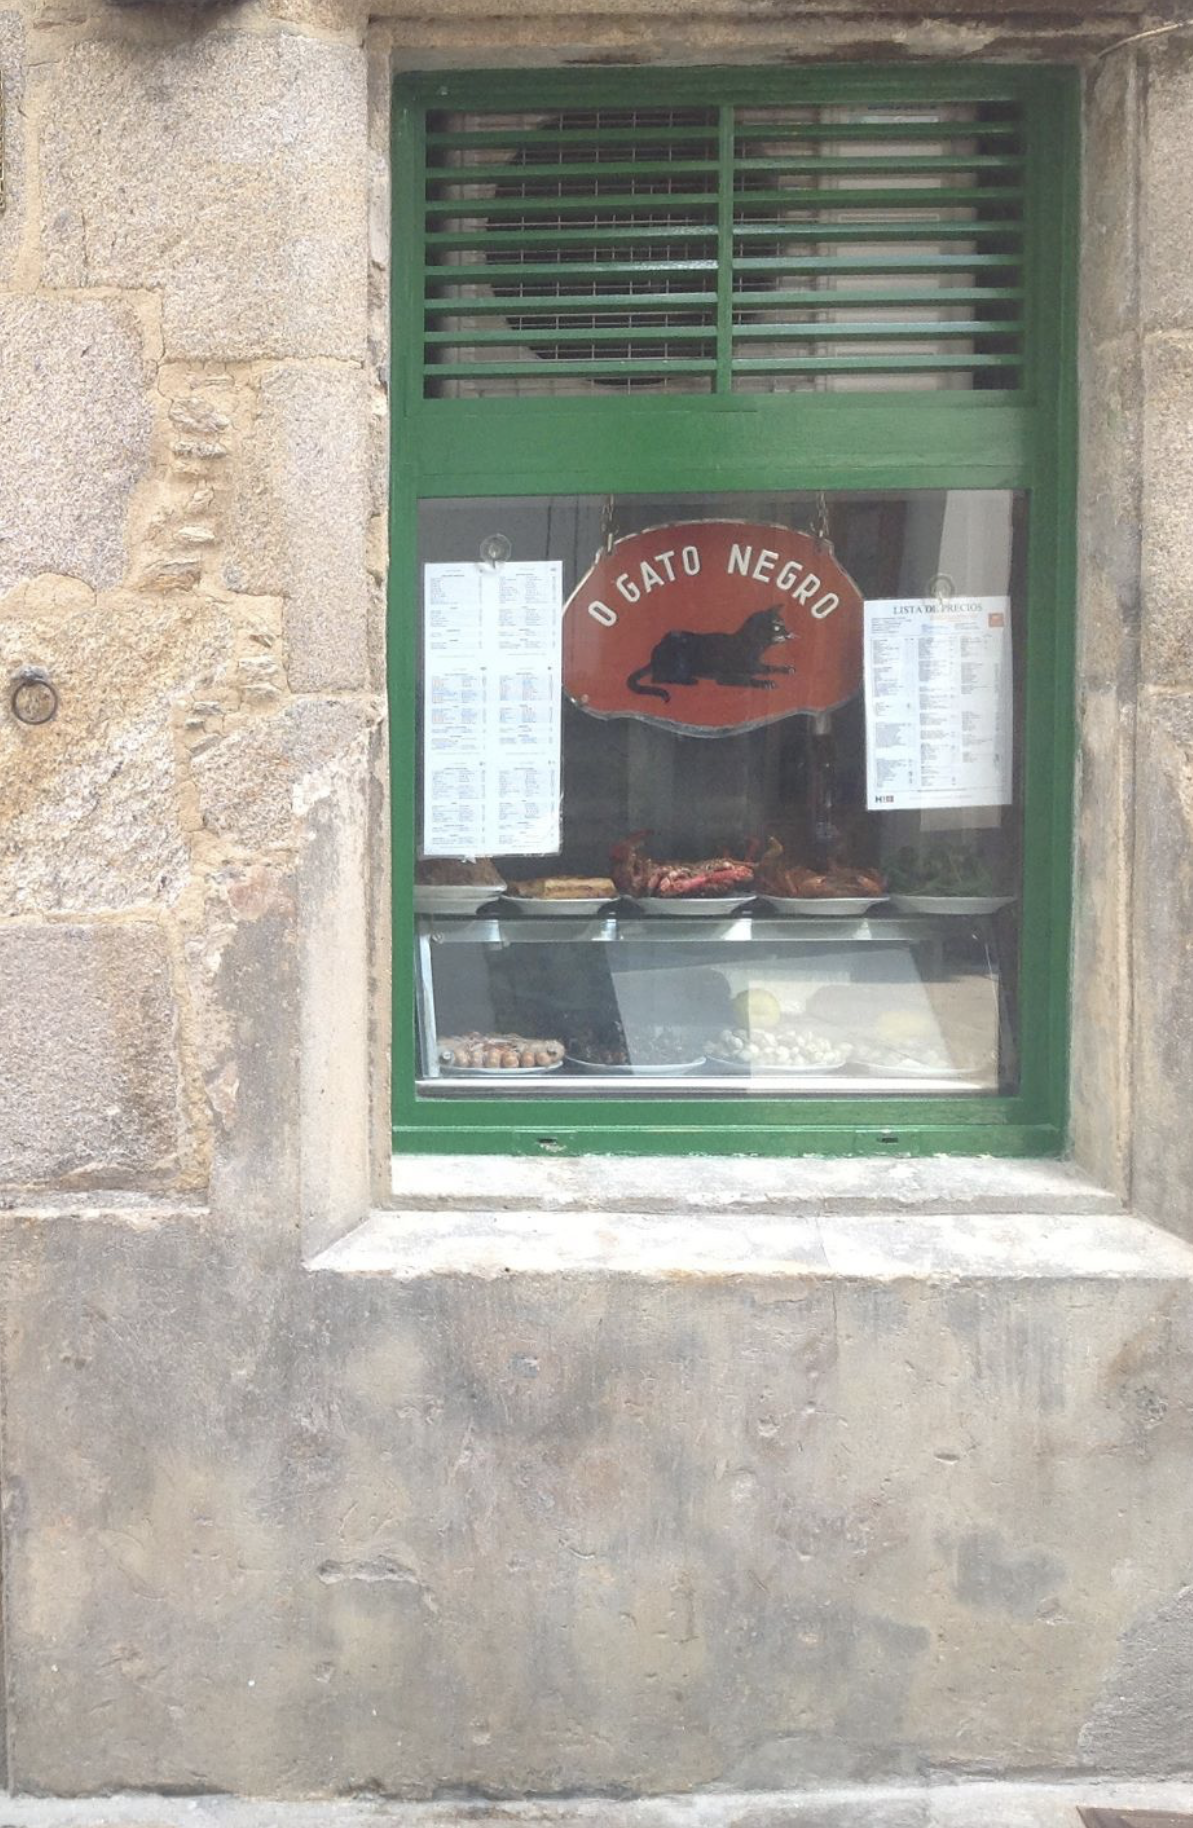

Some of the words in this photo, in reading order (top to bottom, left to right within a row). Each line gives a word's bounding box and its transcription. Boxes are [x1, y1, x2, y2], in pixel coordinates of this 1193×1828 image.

[588, 600, 617, 627] O
[615, 545, 700, 602] GATO
[727, 543, 839, 619] NEGRO
[893, 605, 922, 615] LISTA
[925, 604, 938, 614] DE
[941, 602, 983, 614] PRECIOS
